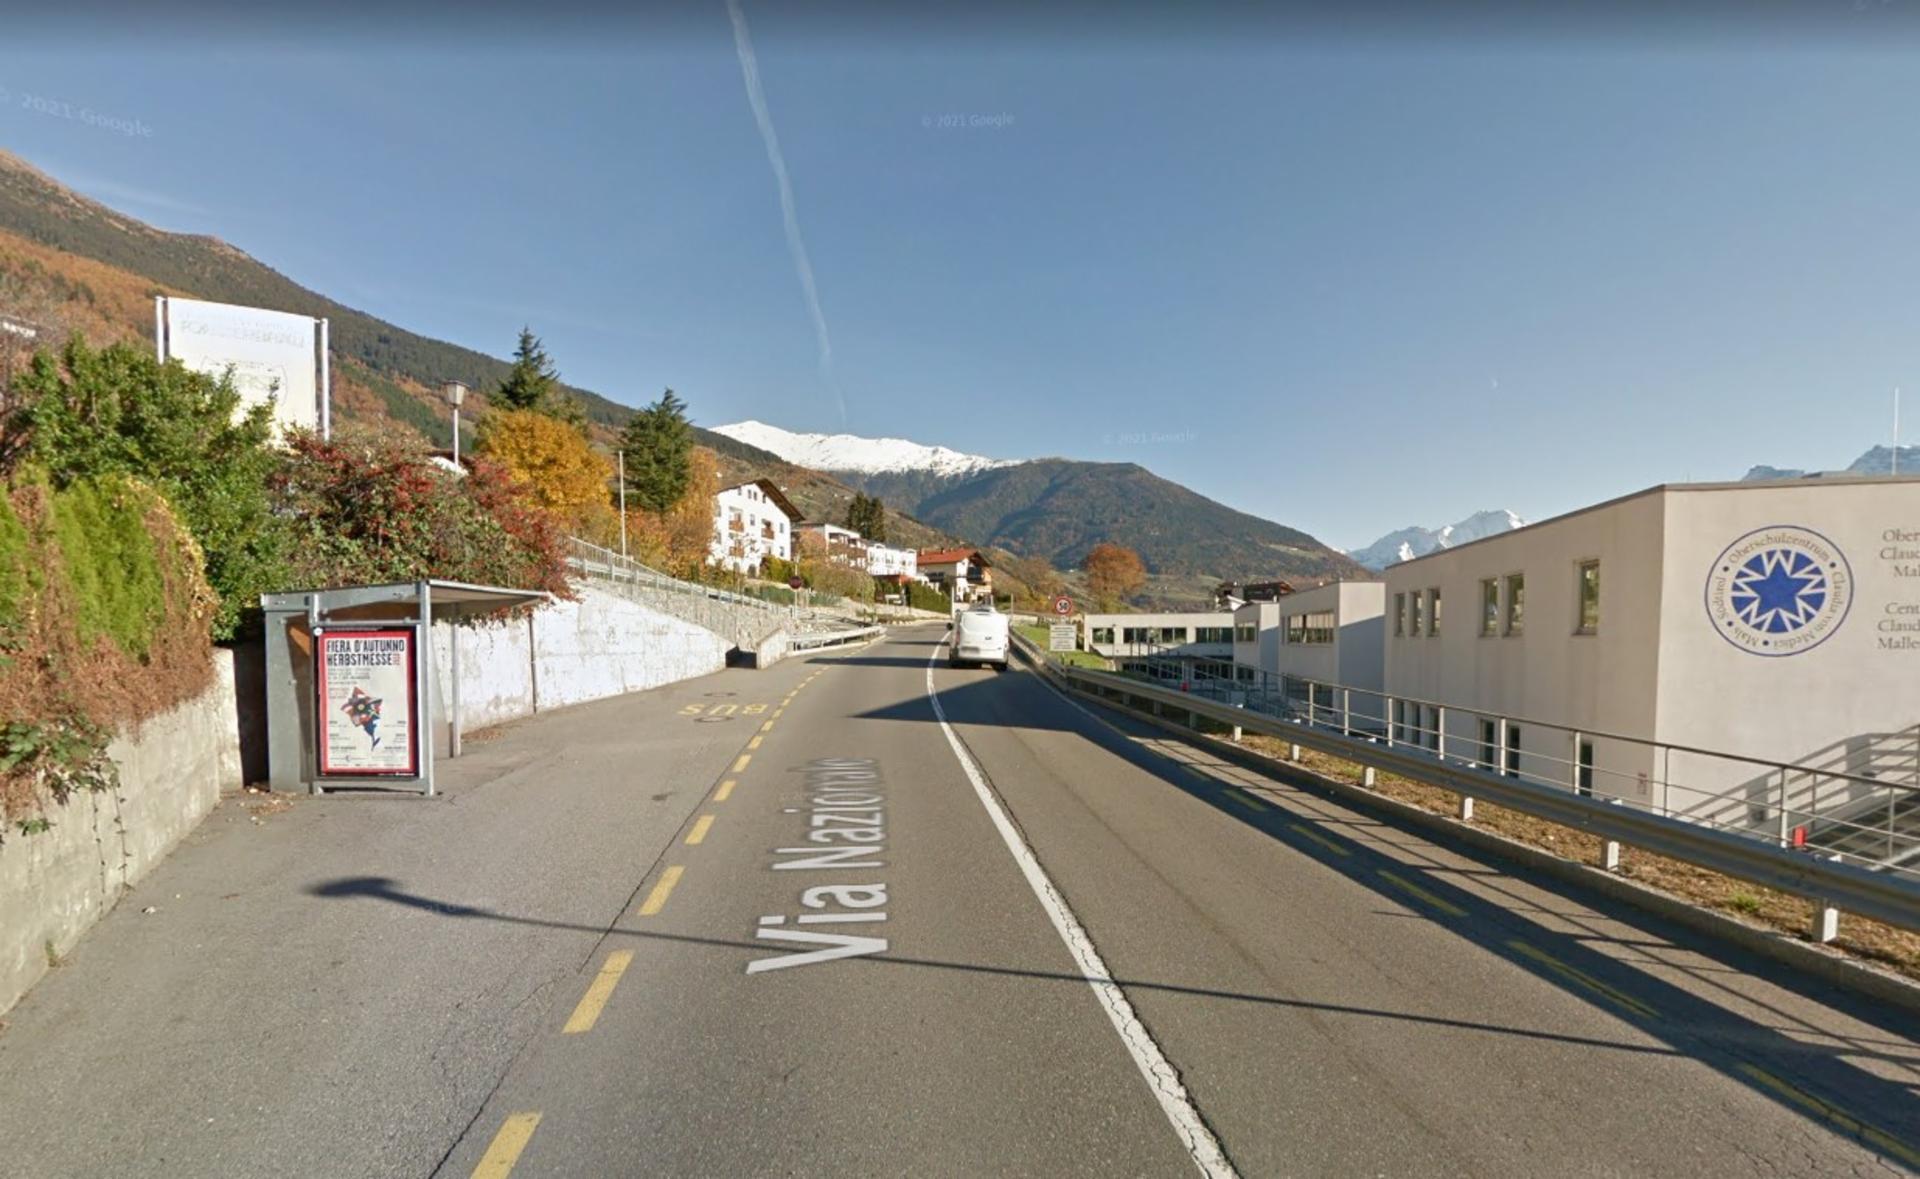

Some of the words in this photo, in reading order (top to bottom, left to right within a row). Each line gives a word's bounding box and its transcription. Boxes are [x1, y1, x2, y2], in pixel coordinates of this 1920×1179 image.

[326, 639, 351, 652] FIERA
[354, 639, 405, 652] D'AUTUNNO
[327, 653, 393, 666] HERBSTMESSE
[677, 702, 769, 716] BUS
